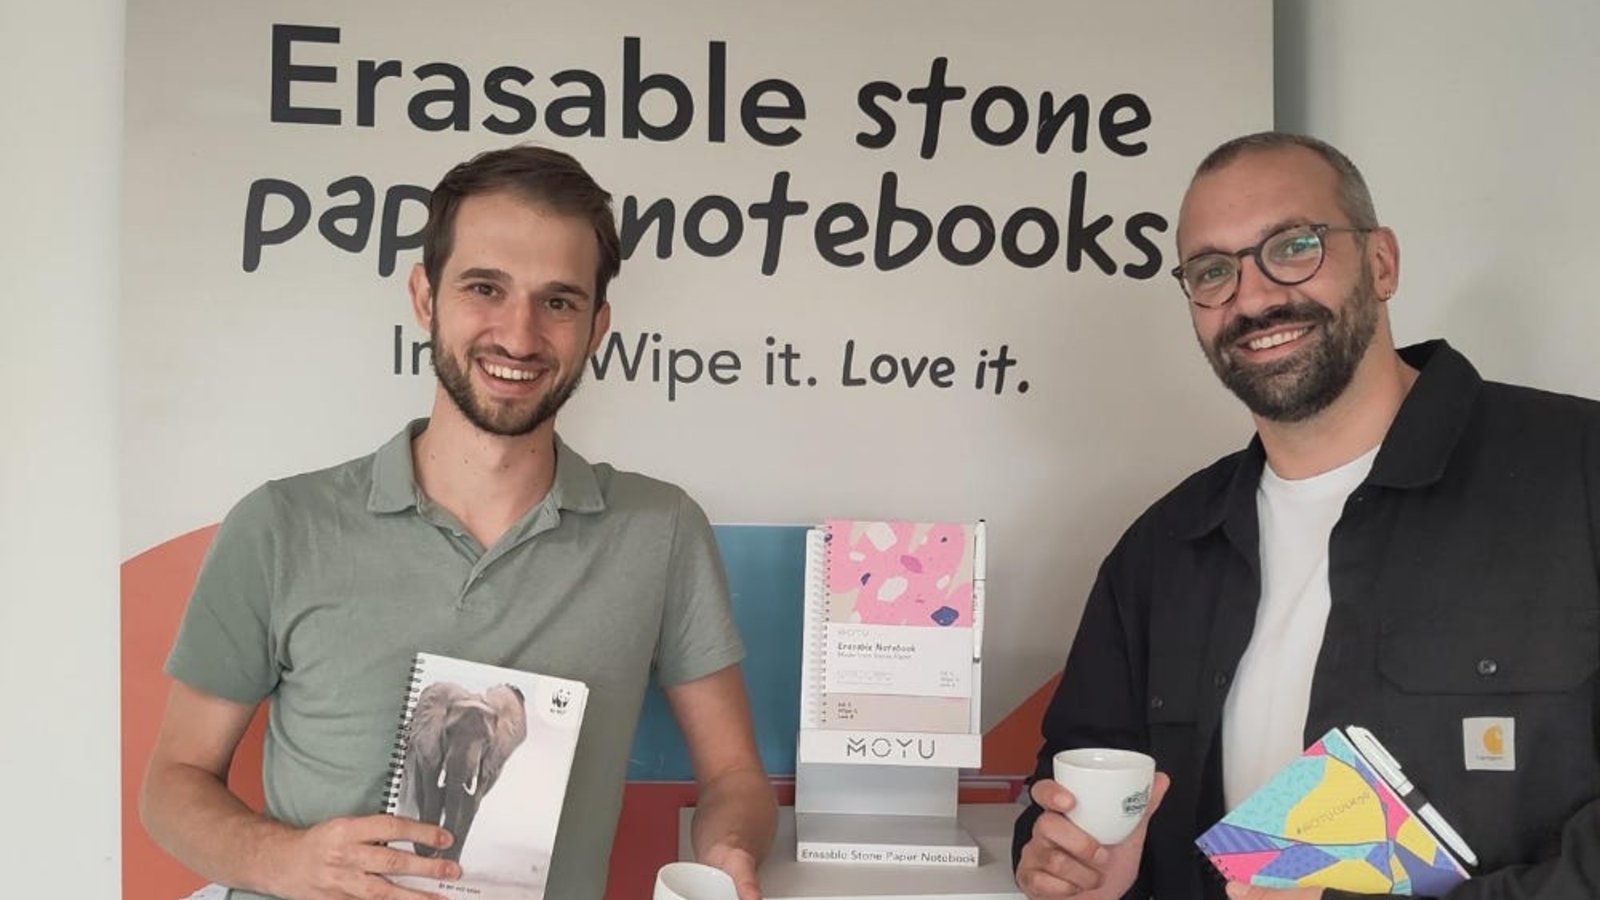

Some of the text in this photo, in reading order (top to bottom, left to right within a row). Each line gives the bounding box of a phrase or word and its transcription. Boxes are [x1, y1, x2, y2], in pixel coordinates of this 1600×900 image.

[271, 24, 1151, 159] Erasable stone
[243, 171, 1168, 279] pap notebooks
[590, 332, 741, 402] Wipe
[766, 337, 816, 386] it.
[842, 340, 955, 388] Love
[976, 345, 1029, 394] it.
[876, 643, 915, 652] Notebook
[846, 737, 935, 759] MOYU
[801, 848, 976, 863] Erasable Stone Paper Notebook
